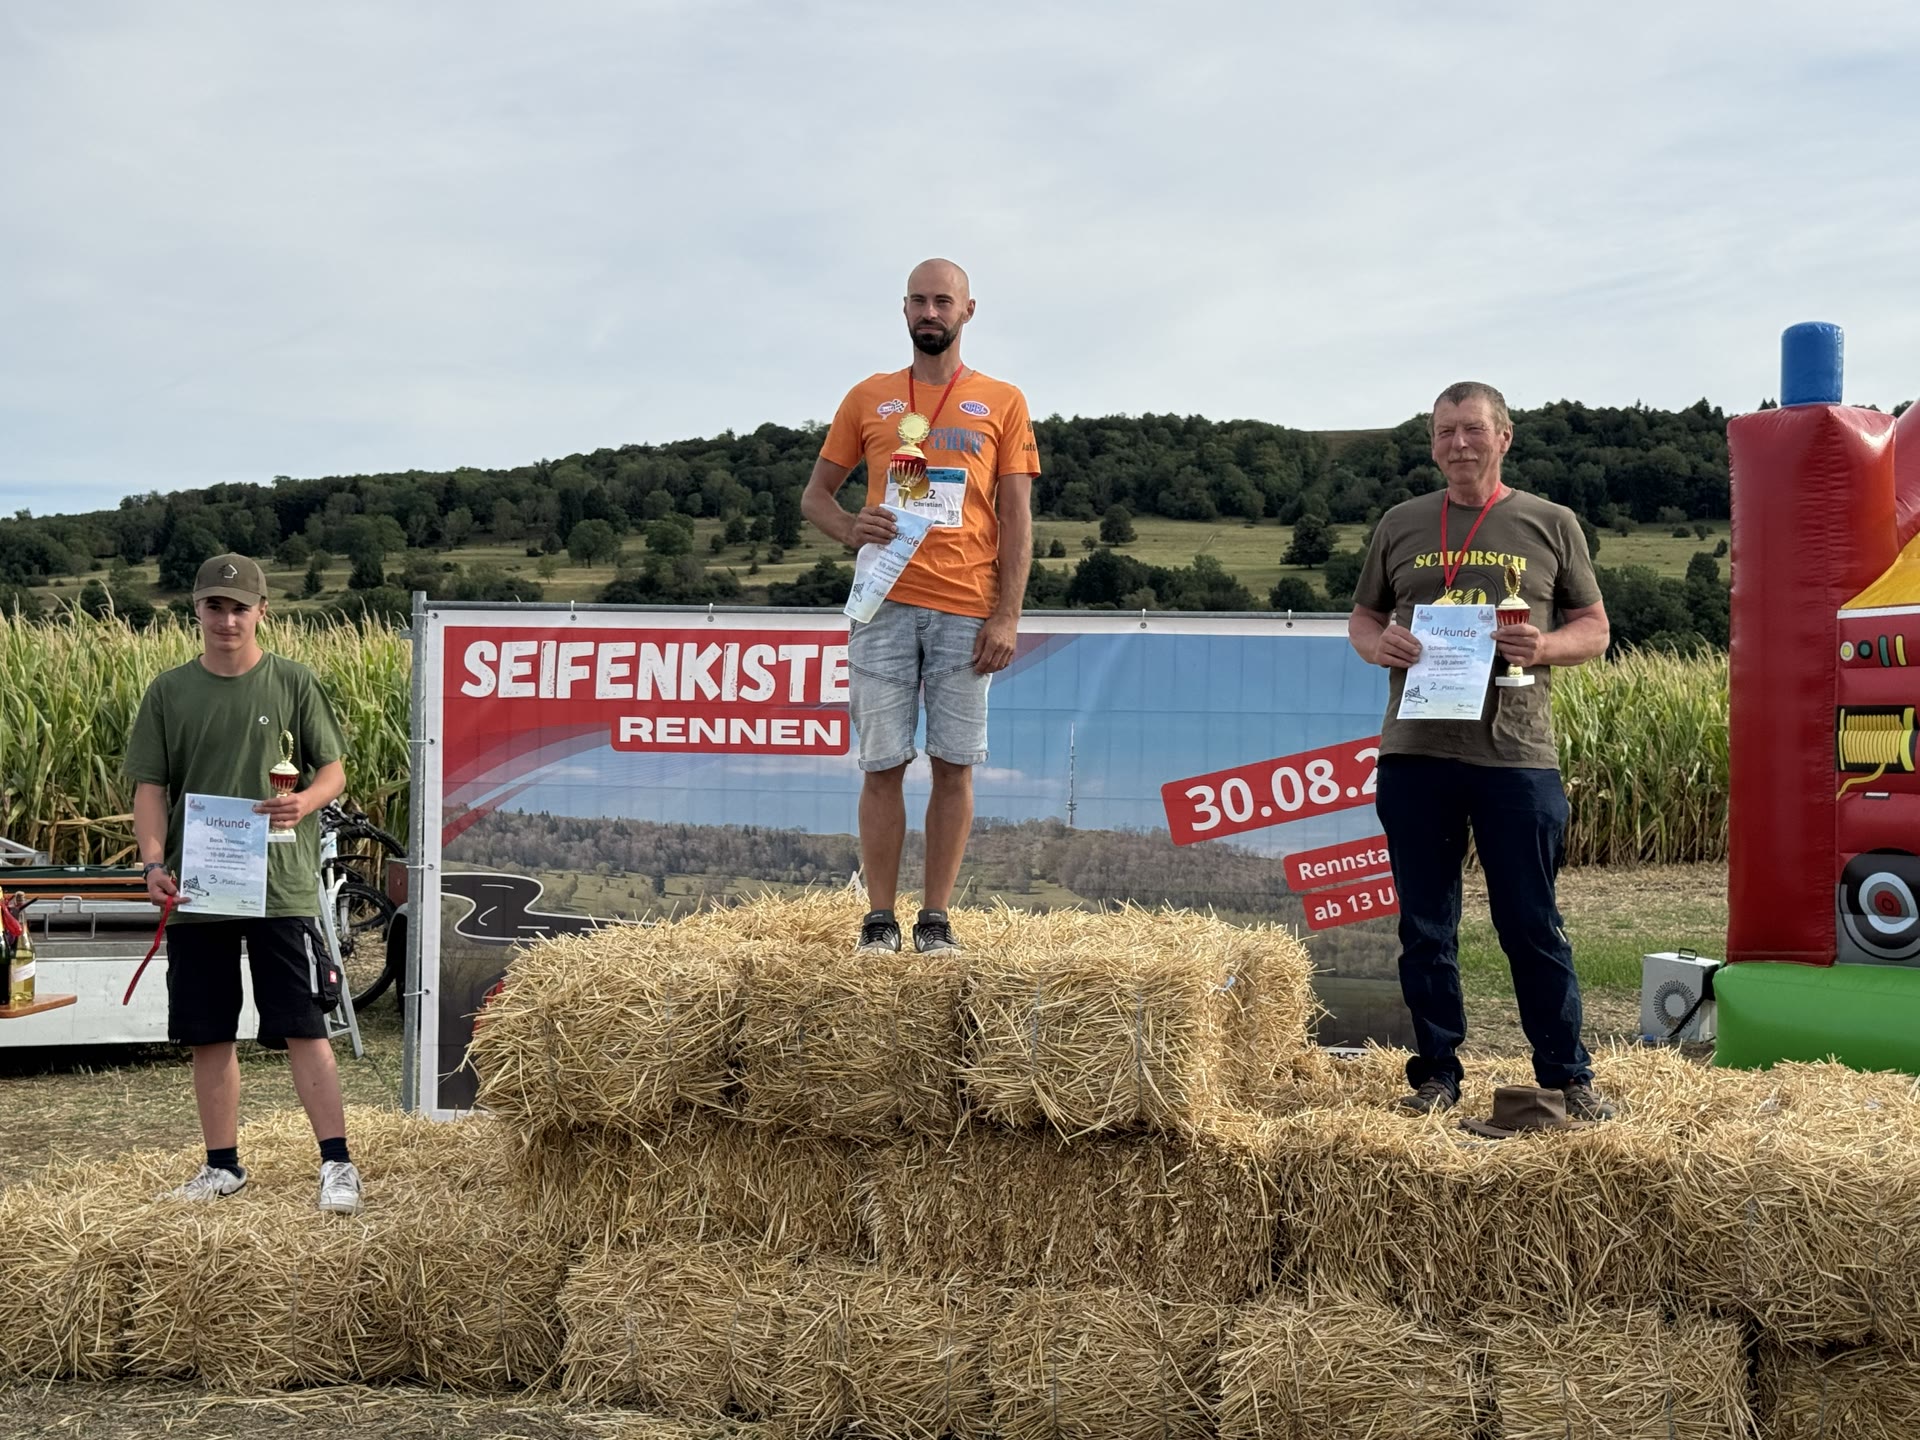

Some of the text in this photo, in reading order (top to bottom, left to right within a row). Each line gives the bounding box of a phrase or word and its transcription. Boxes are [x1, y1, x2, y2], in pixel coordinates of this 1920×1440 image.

[1413, 550, 1528, 571] SCHORSCH
[1431, 626, 1477, 638] Urkunde
[460, 640, 850, 703] SEIFENKISTE
[619, 716, 842, 746] RENNEN
[1185, 747, 1380, 832] 30.08.2
[206, 816, 251, 829] Urkunde
[208, 874, 218, 884] 3
[1298, 847, 1391, 881] Rennsta
[1314, 900, 1342, 921] ab
[1347, 891, 1373, 913] 13
